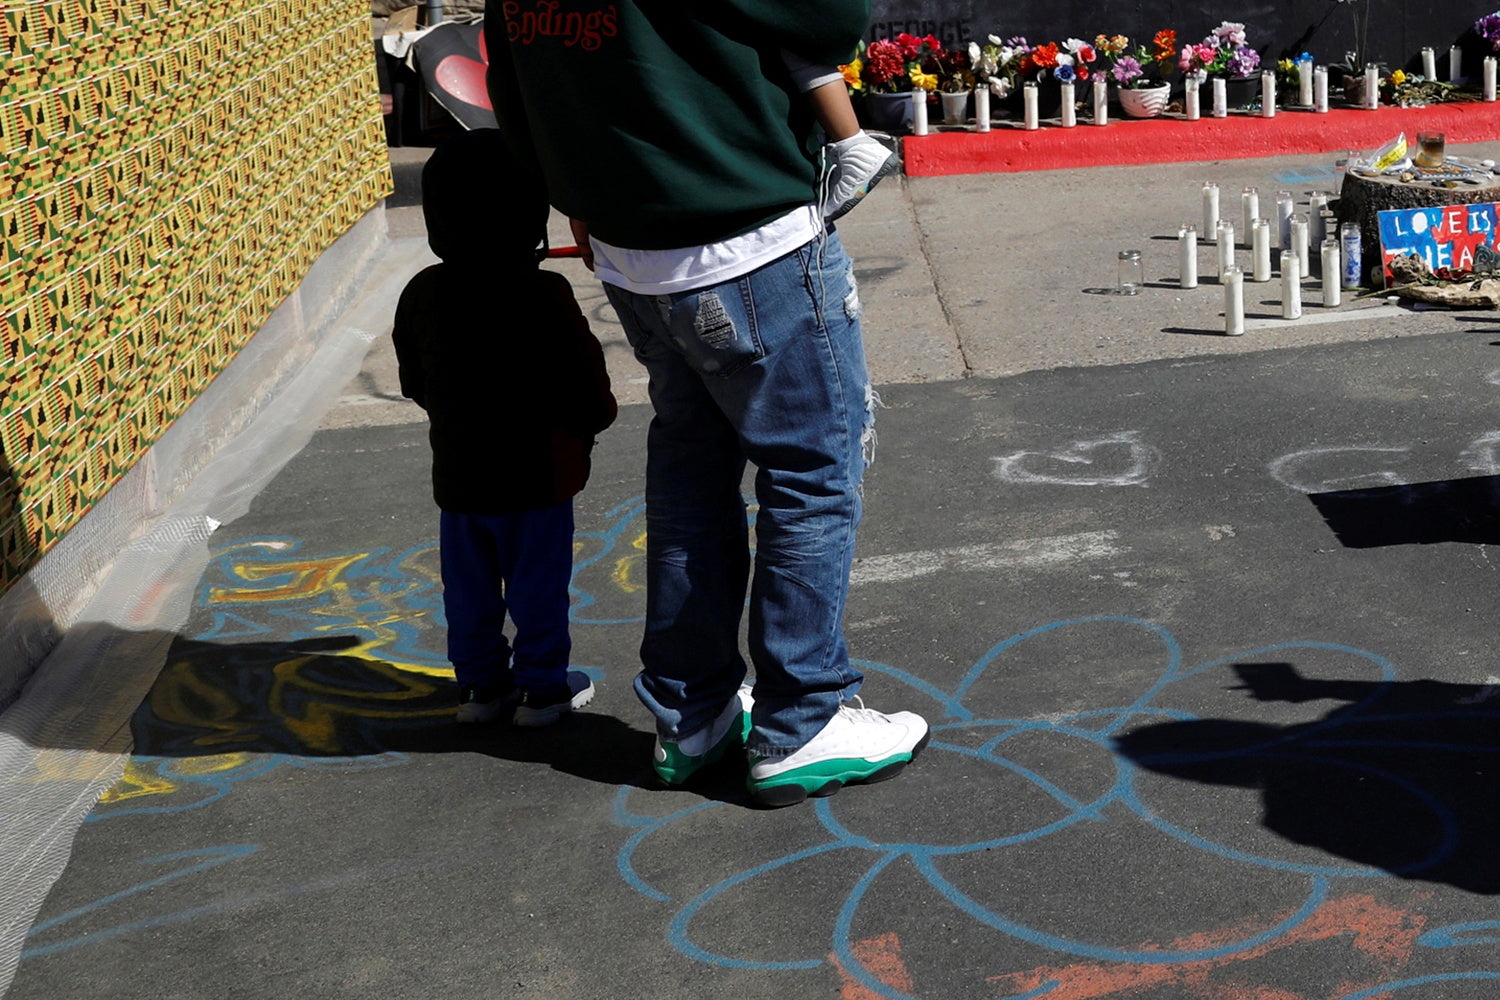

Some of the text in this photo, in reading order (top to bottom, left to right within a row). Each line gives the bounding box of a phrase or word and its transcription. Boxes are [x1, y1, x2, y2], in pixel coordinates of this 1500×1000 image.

[502, 0, 620, 51] Endings
[1395, 210, 1491, 237] LOVE IS
